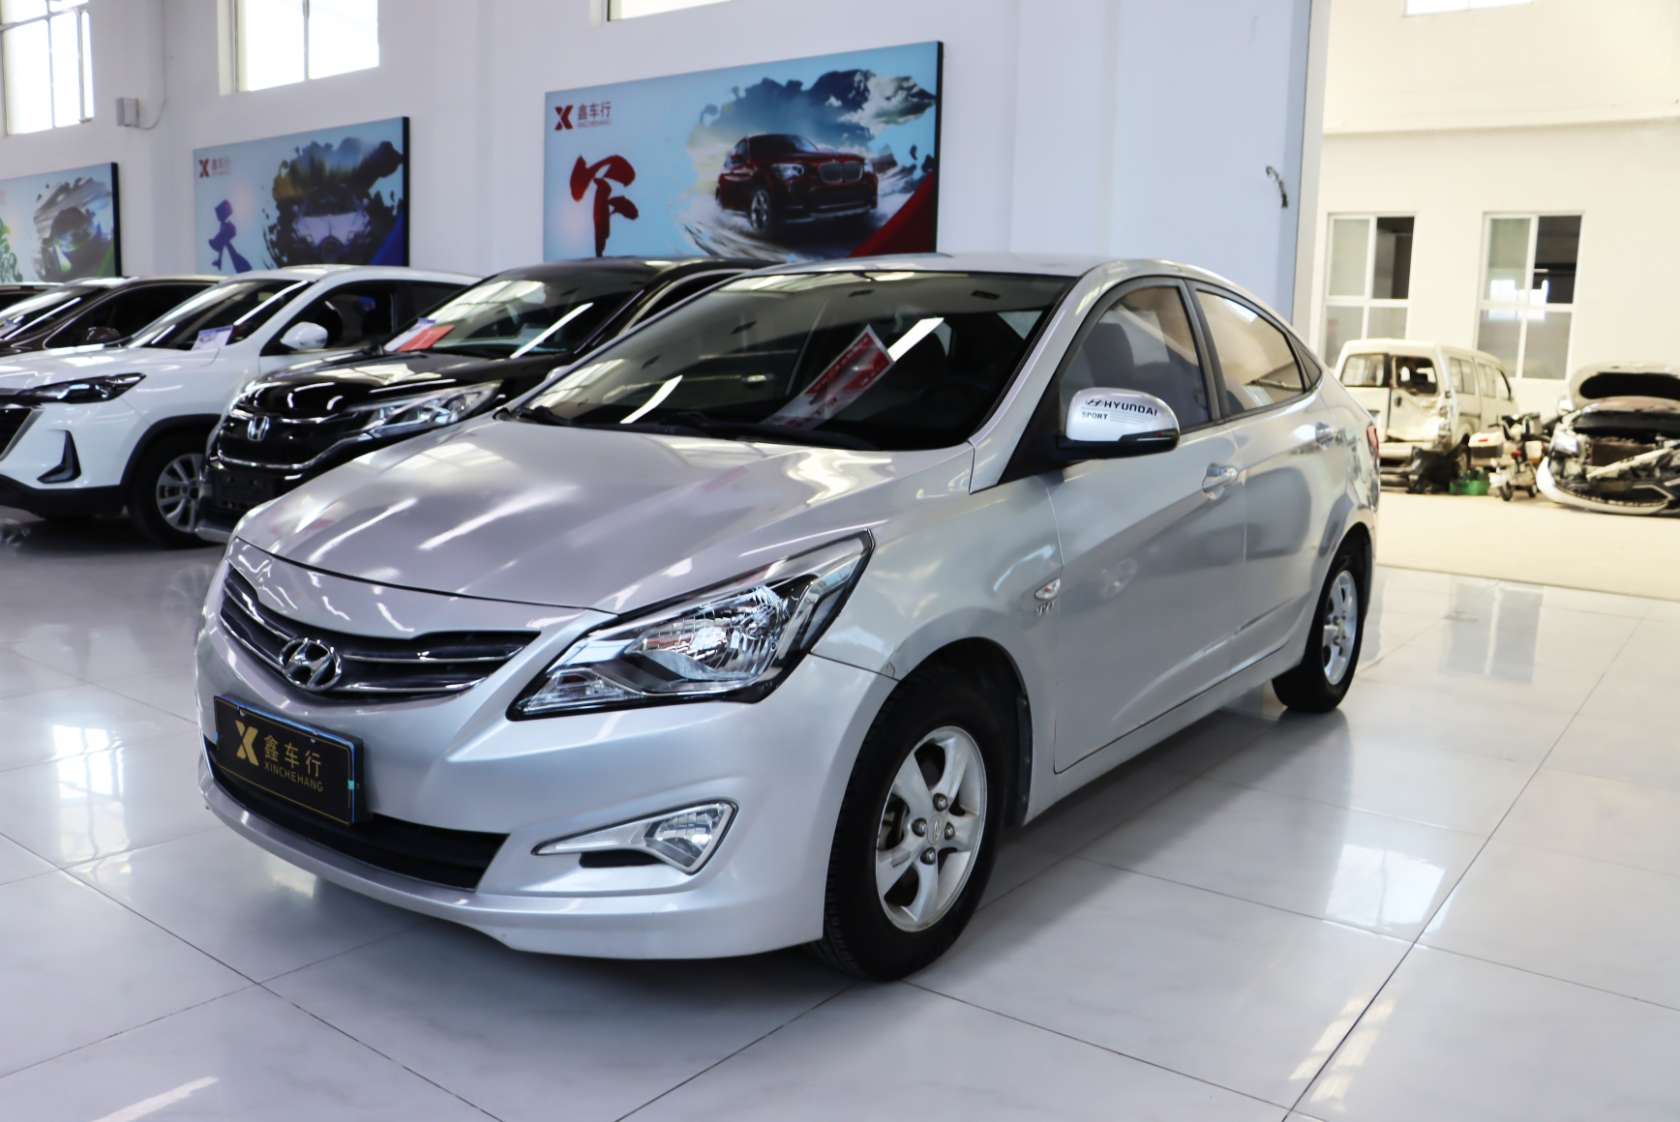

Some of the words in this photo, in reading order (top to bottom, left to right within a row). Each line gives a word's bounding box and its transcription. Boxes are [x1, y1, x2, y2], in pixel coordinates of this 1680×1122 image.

[1081, 411, 1108, 420] SPORT
[1104, 400, 1158, 417] HYUNDAI
[264, 735, 321, 777] 鑫车行
[263, 761, 324, 792] XINCHEHANG
